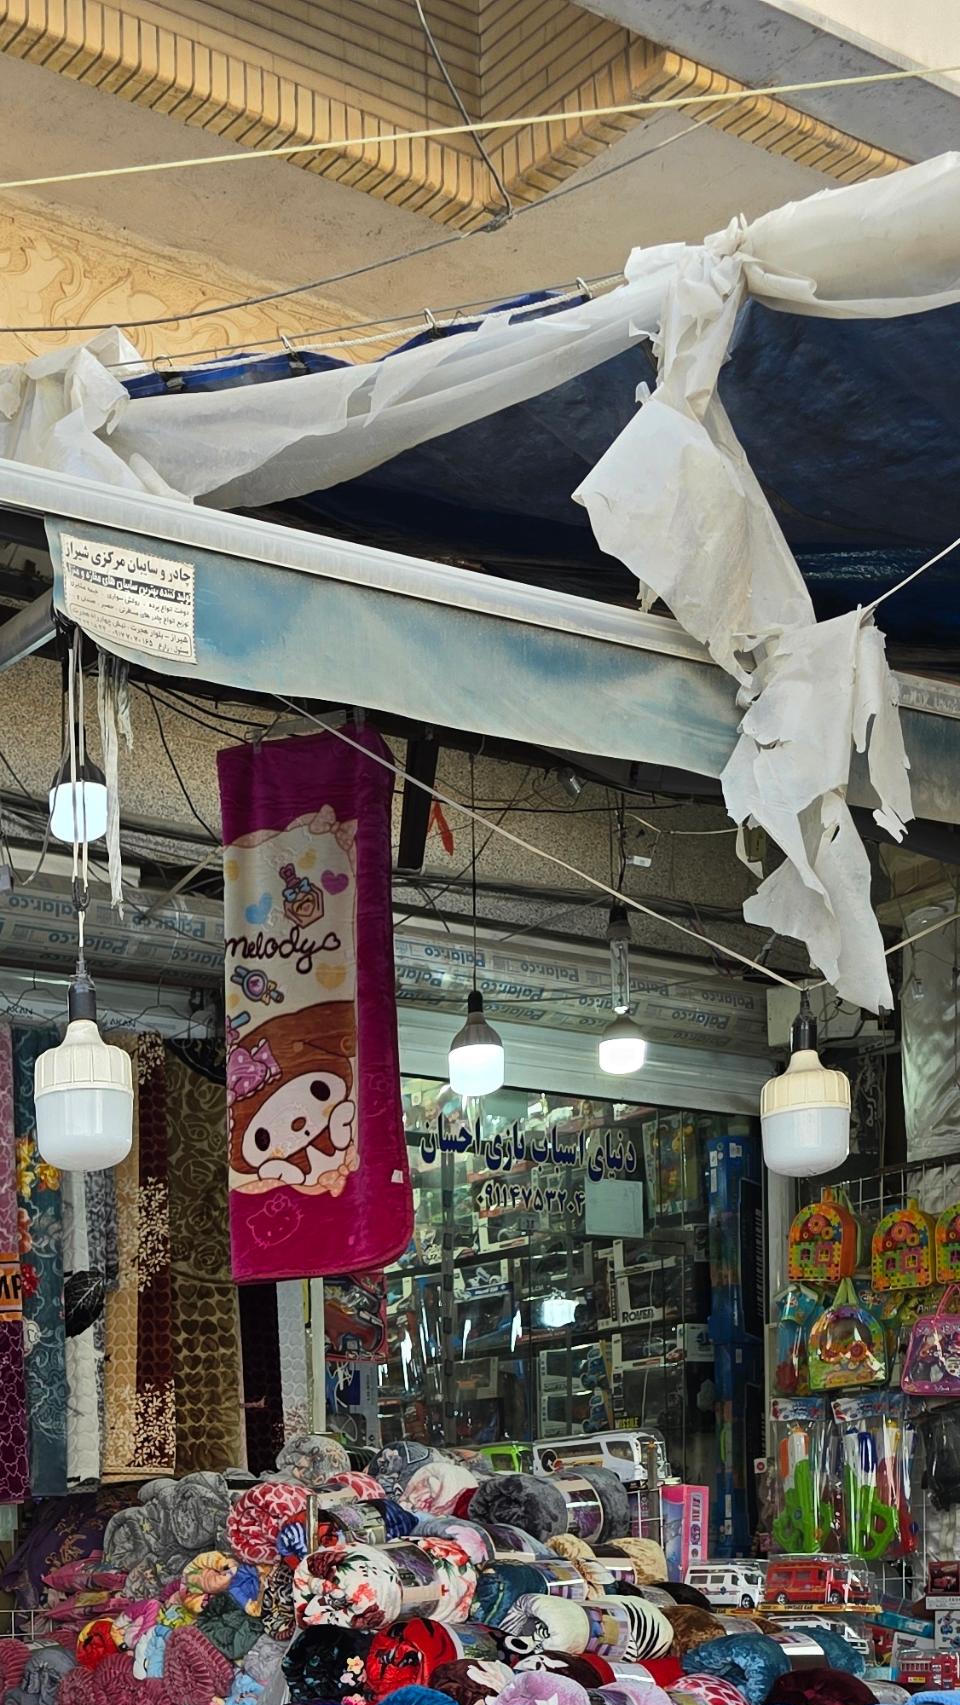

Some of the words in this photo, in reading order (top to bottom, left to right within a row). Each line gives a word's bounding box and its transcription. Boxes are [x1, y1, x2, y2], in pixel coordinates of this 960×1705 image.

[65, 541, 90, 561] شیراز
[91, 550, 126, 570] مرکزی
[127, 557, 158, 576] سایبان
[160, 570, 166, 581] و
[169, 567, 191, 587] چادر
[420, 1112, 482, 1164] احسان
[484, 1120, 527, 1171] بازی
[531, 1125, 586, 1173] اسباب
[587, 1128, 637, 1182] دنیای
